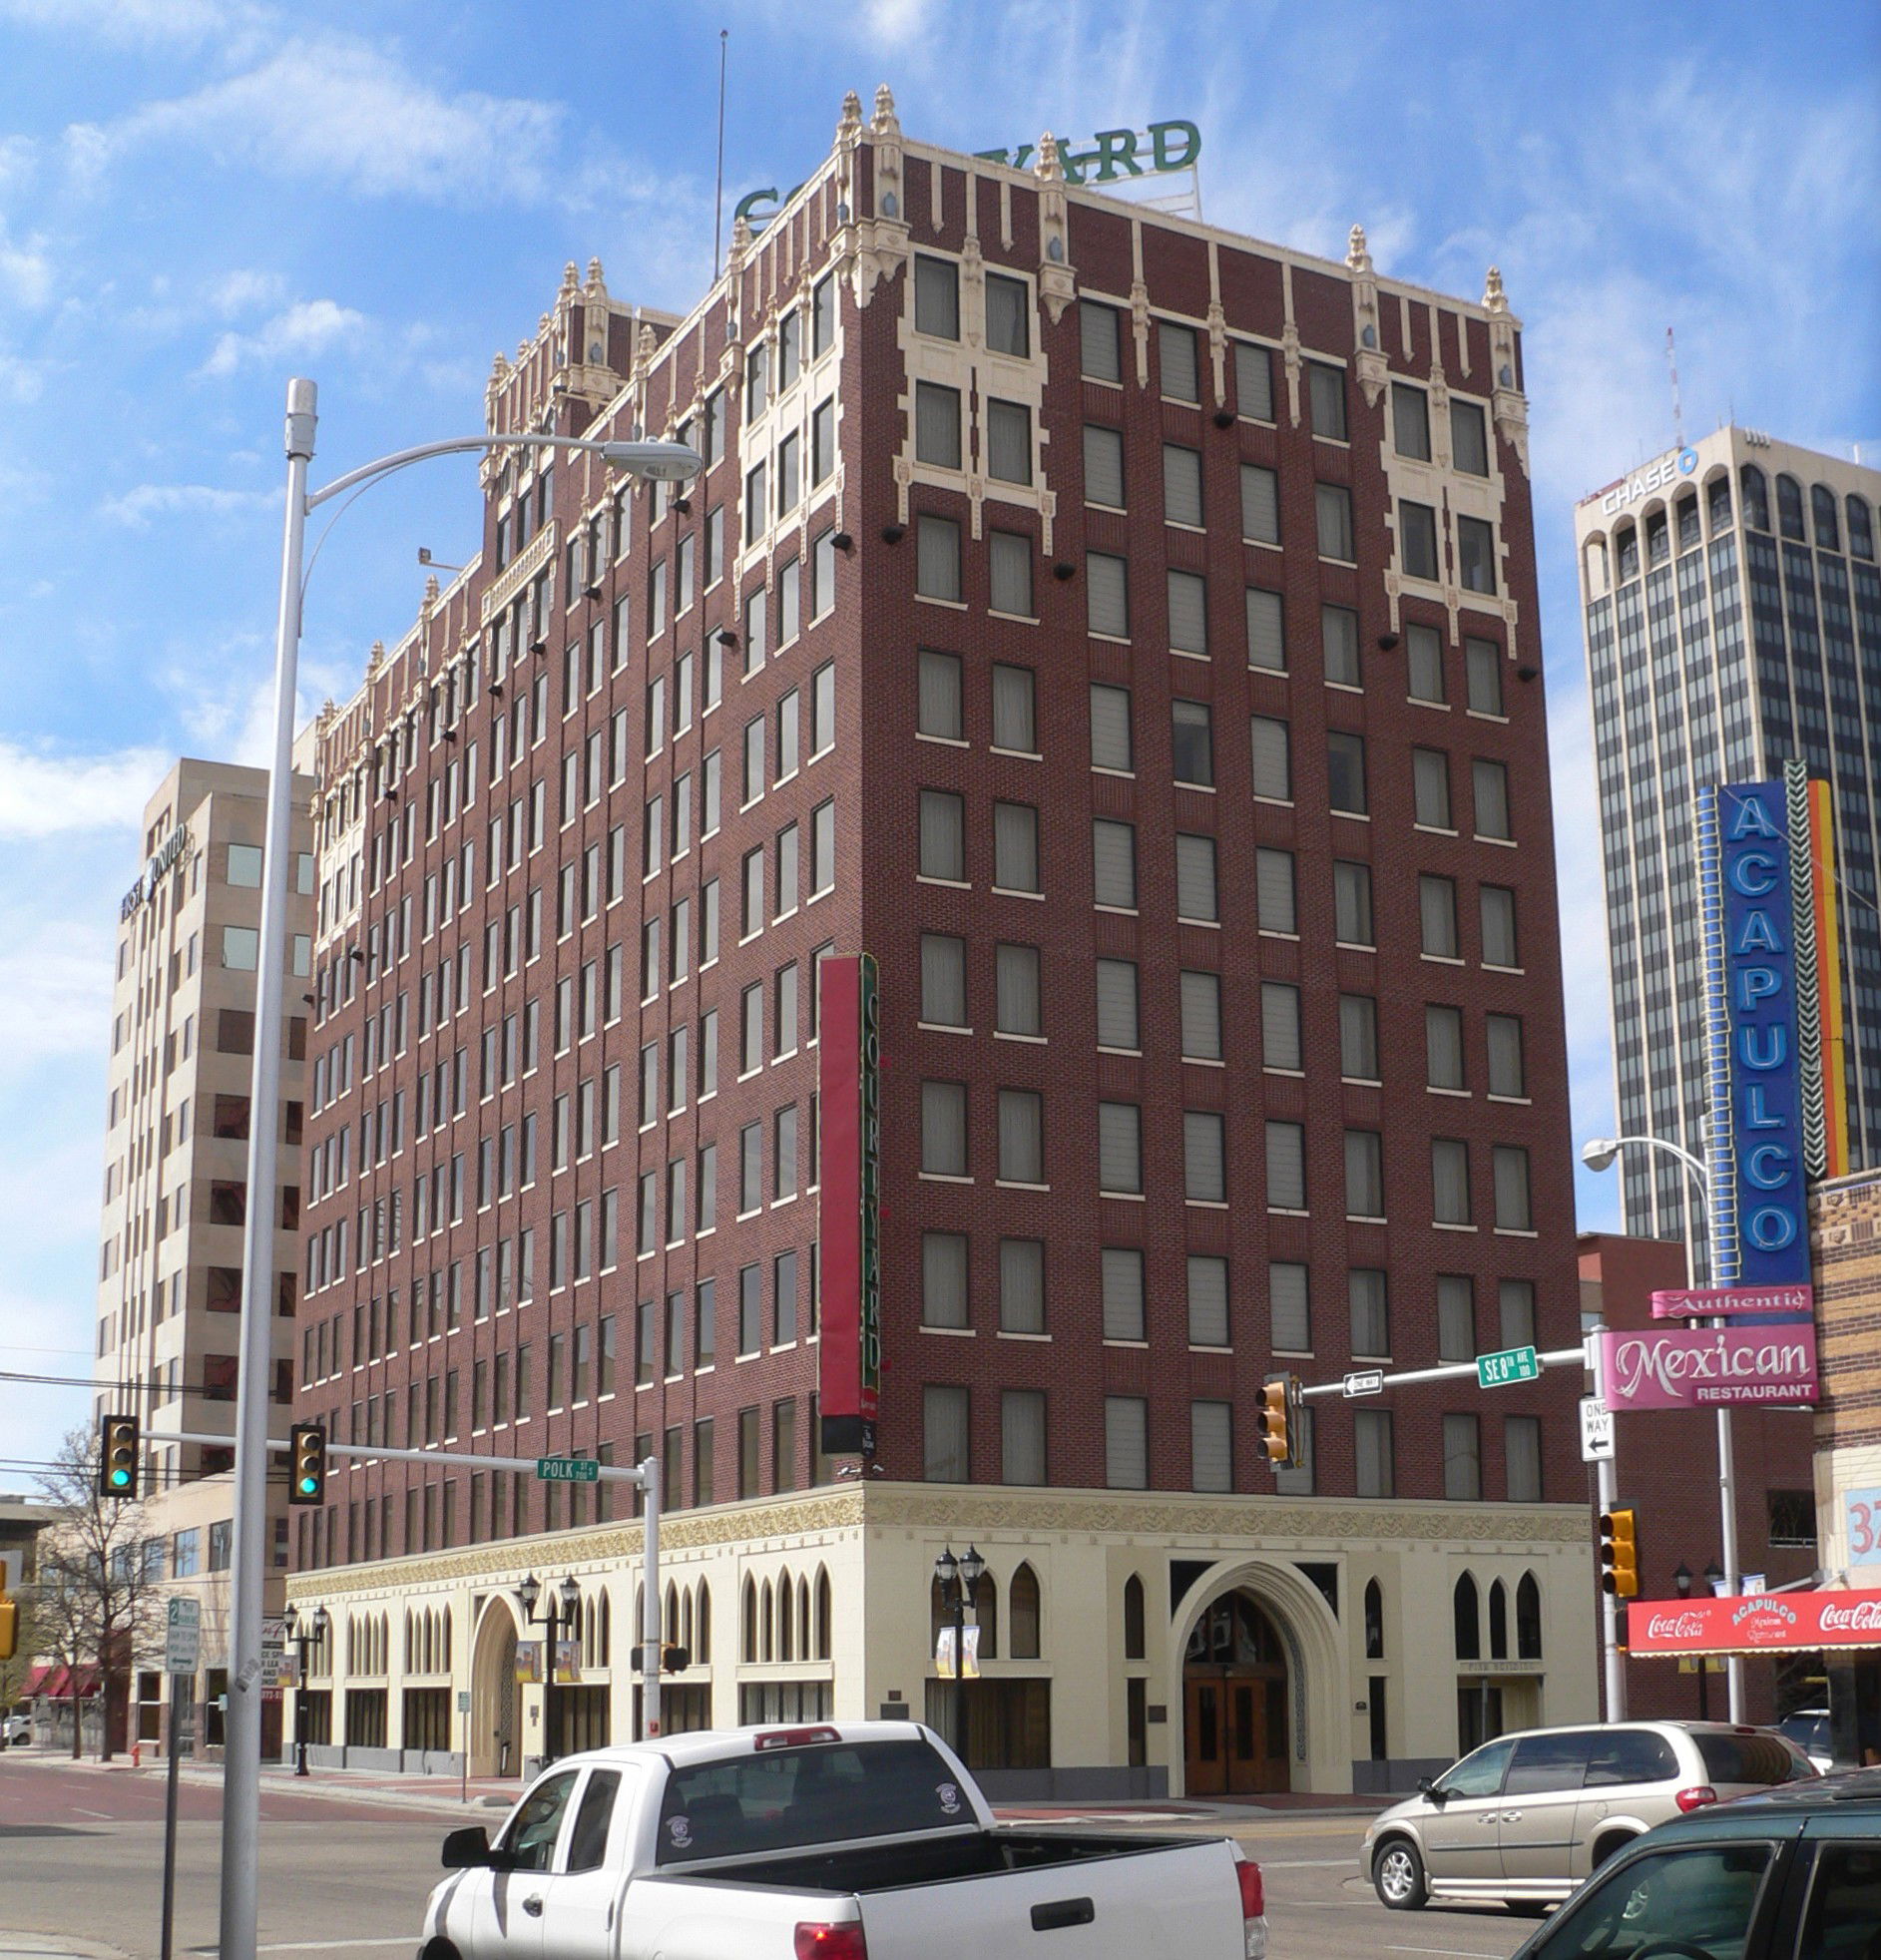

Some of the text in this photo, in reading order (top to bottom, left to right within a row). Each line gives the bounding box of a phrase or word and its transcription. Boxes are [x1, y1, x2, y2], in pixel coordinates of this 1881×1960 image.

[1601, 457, 1675, 517] CHASE
[1726, 794, 1797, 1252] ACAPULCO
[867, 992, 881, 1371] COURTYARD
[1668, 1291, 1806, 1315] Authentic
[1485, 1358, 1500, 1382] SE
[1613, 1334, 1811, 1398] Mexican
[1697, 1384, 1813, 1401] RESTAURANT
[1587, 1403, 1608, 1418] ONE
[1587, 1418, 1608, 1434] WAY
[543, 1461, 574, 1479] POLK
[1850, 1500, 1881, 1554] 3
[1731, 1598, 1797, 1627] ACAPULCO
